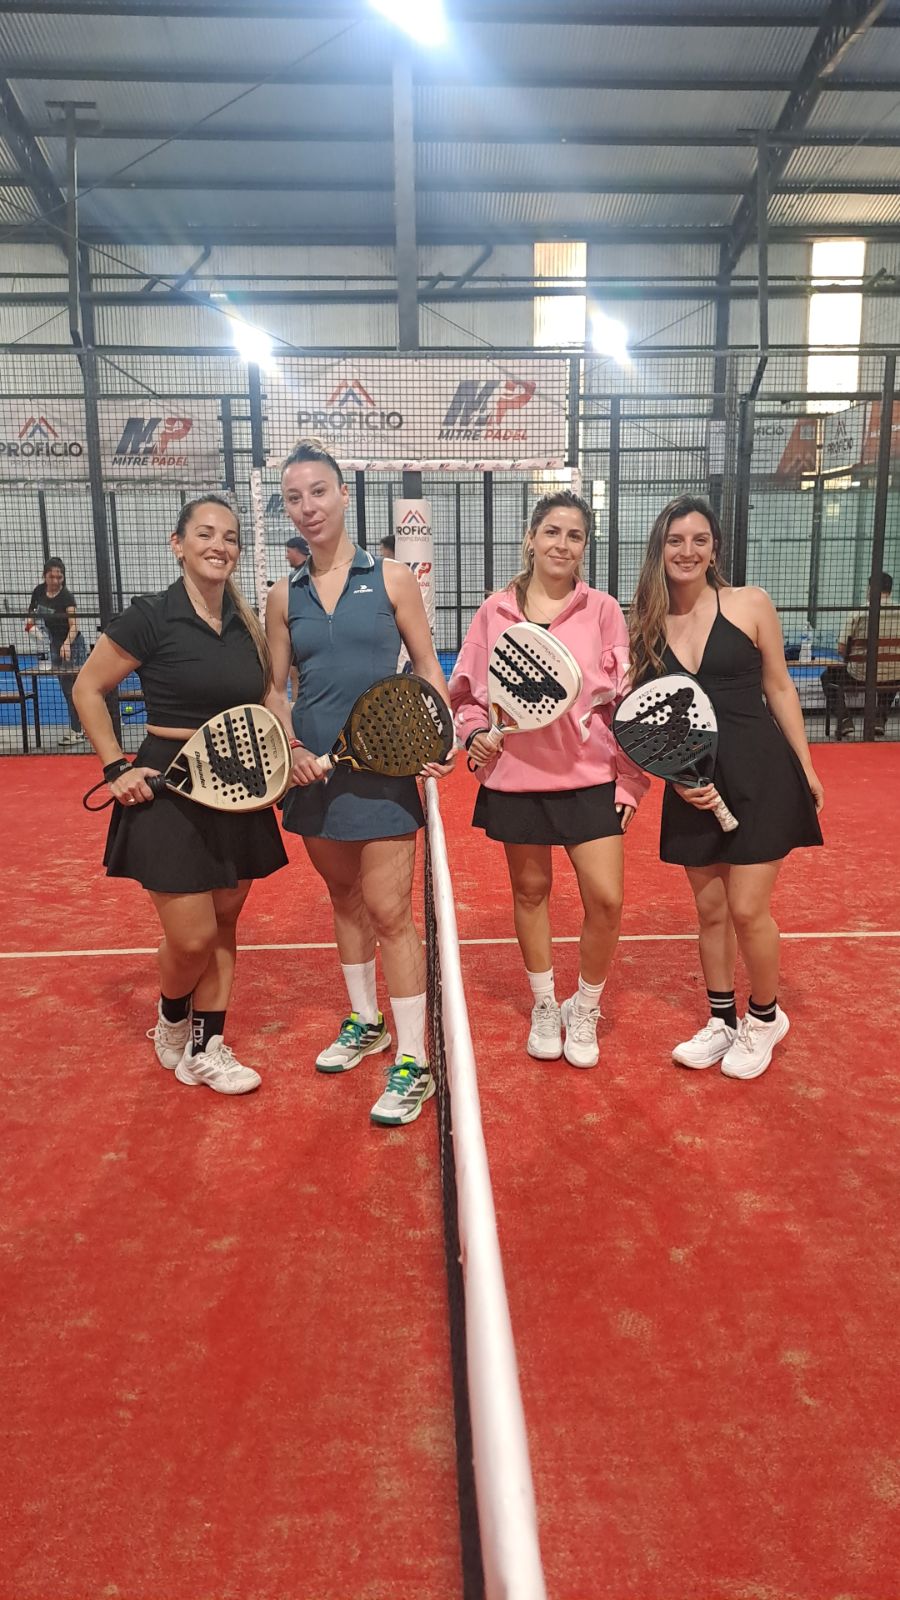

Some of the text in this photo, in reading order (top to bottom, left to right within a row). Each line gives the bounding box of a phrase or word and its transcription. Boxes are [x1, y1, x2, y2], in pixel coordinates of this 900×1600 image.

[297, 411, 403, 429] PROFICIO
[437, 429, 528, 441] MITRE PADEL
[112, 456, 188, 466] MITRE PADEL
[421, 692, 444, 736] SIUX
[194, 750, 207, 789] Bullpadel
